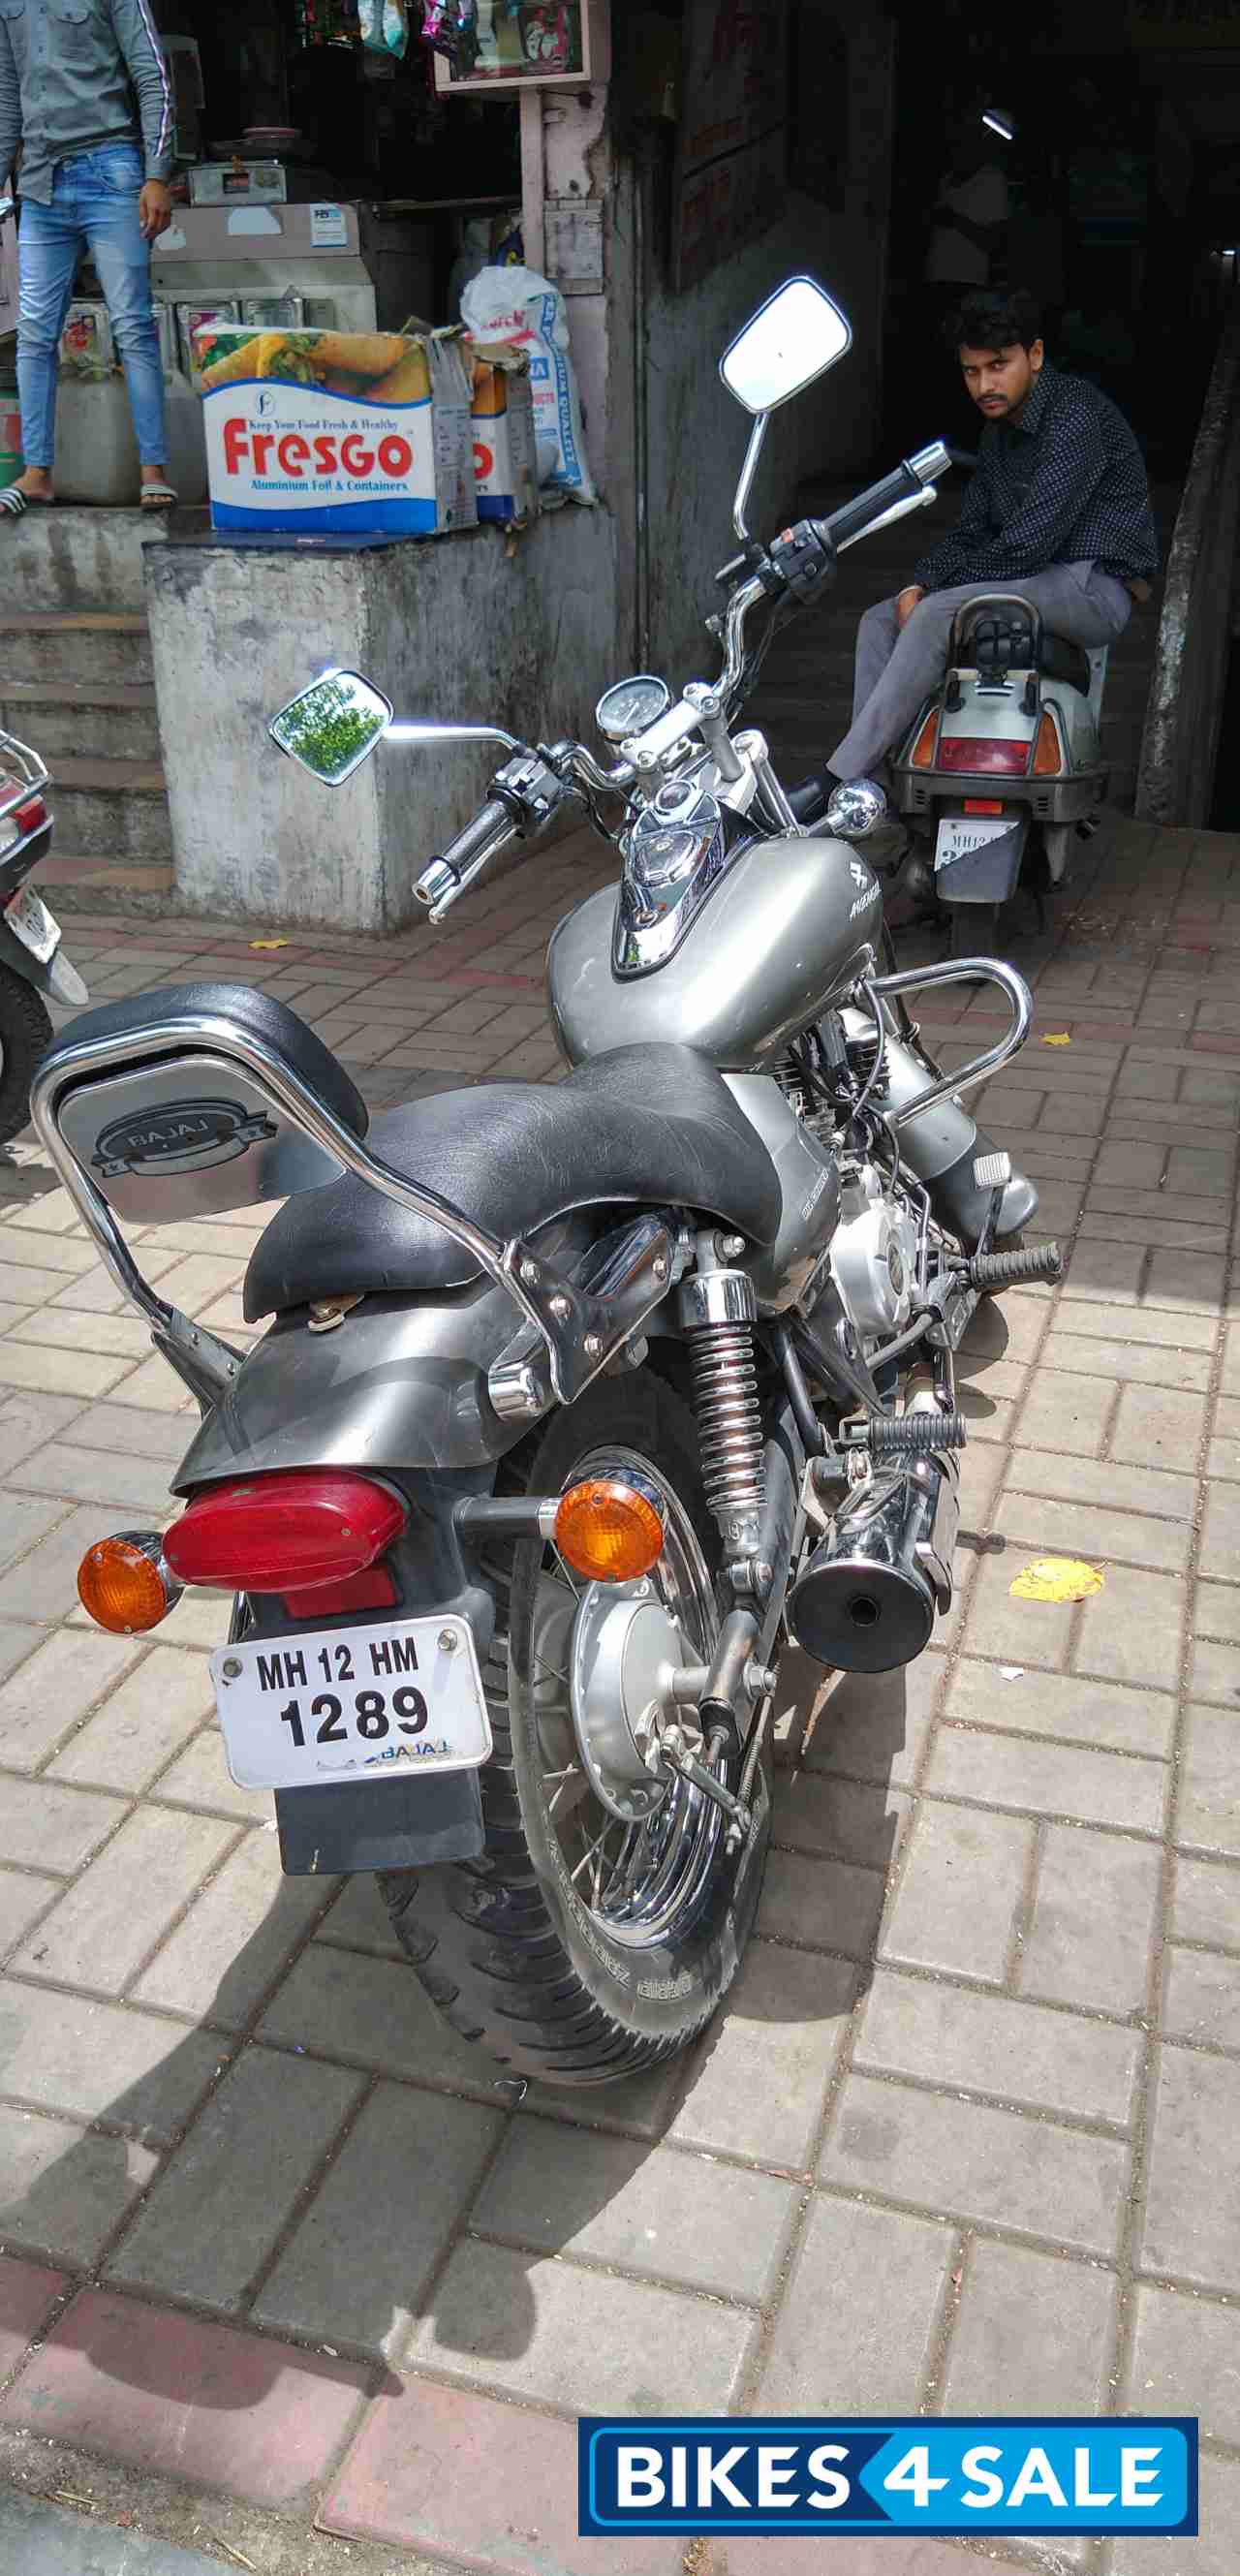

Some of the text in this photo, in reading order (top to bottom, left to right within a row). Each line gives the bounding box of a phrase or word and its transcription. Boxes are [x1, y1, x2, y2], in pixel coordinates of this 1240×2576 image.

[248, 419, 272, 432] Keep
[297, 419, 321, 429] Food
[323, 419, 347, 429] Fresh
[361, 419, 398, 431] Healthy
[251, 480, 308, 491] Aluminium
[311, 480, 331, 491] Foil
[347, 479, 409, 491] Containers
[127, 1119, 209, 1148] BAJAJ
[256, 1636, 419, 1691] MH 12 HM
[280, 1686, 428, 1747] 1289
